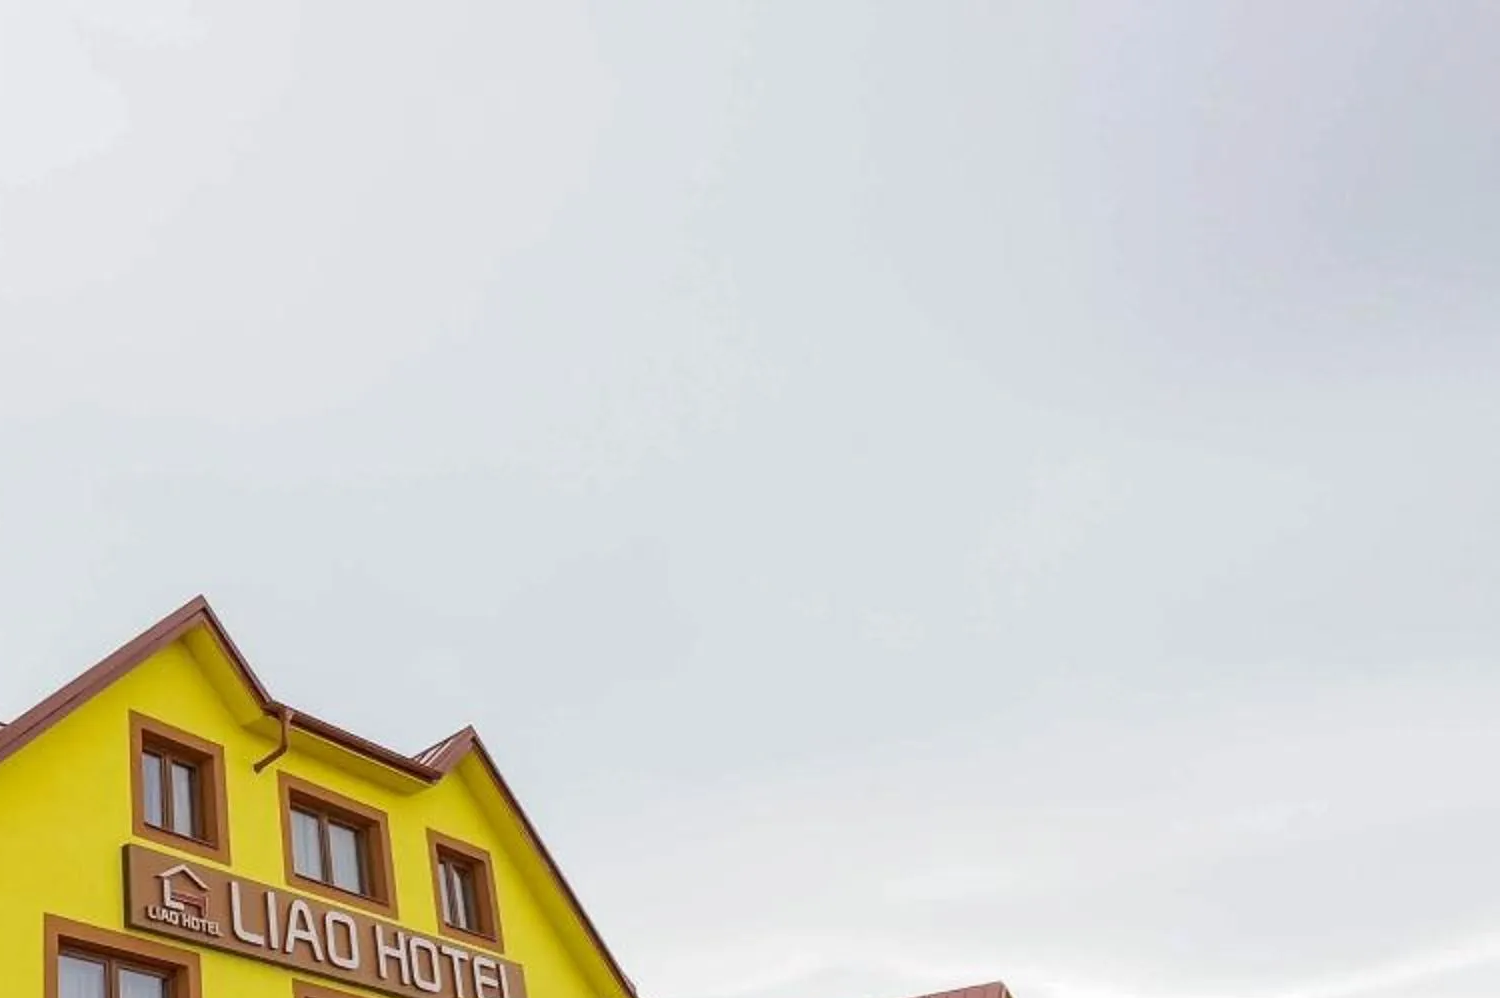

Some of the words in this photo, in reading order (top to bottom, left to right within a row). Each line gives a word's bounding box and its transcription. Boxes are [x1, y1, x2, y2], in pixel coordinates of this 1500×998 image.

[147, 905, 179, 925] LIAO
[181, 914, 224, 937] HOTEL
[230, 880, 359, 969] LIAO
